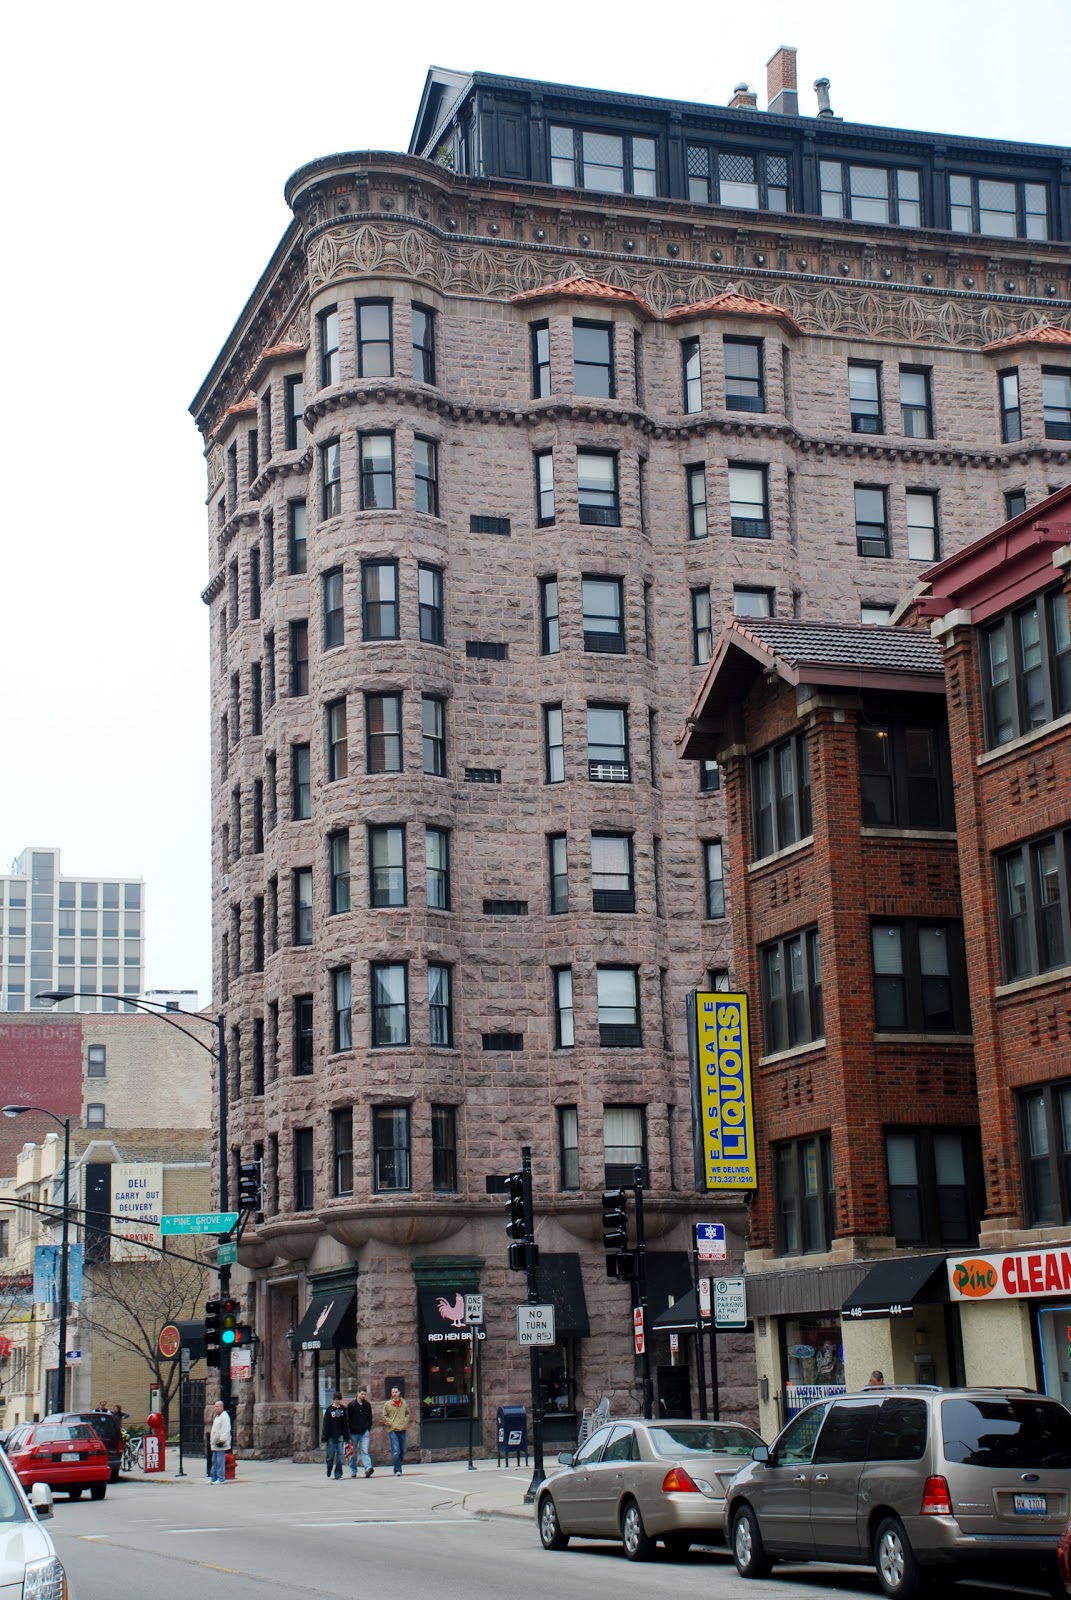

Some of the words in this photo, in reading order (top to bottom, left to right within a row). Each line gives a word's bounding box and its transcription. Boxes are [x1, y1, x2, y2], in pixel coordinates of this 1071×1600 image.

[703, 1001, 720, 1160] EASTGATE
[717, 1004, 747, 1156] LIQUORS
[140, 1167, 158, 1175] EAST
[128, 1179, 147, 1188] DELI
[115, 1192, 140, 1200] CARRY
[145, 1191, 160, 1199] OUT
[119, 1203, 153, 1212] DELIVERY
[173, 1217, 191, 1226] PINE
[195, 1216, 222, 1225] GROVE
[955, 1264, 995, 1296] Pine
[529, 1310, 542, 1319] NO
[850, 1307, 862, 1317] 446
[890, 1304, 902, 1314] 444
[526, 1321, 547, 1330] TURN
[444, 1333, 460, 1341] HEN
[461, 1332, 486, 1340] BRAD
[521, 1333, 532, 1341] ON
